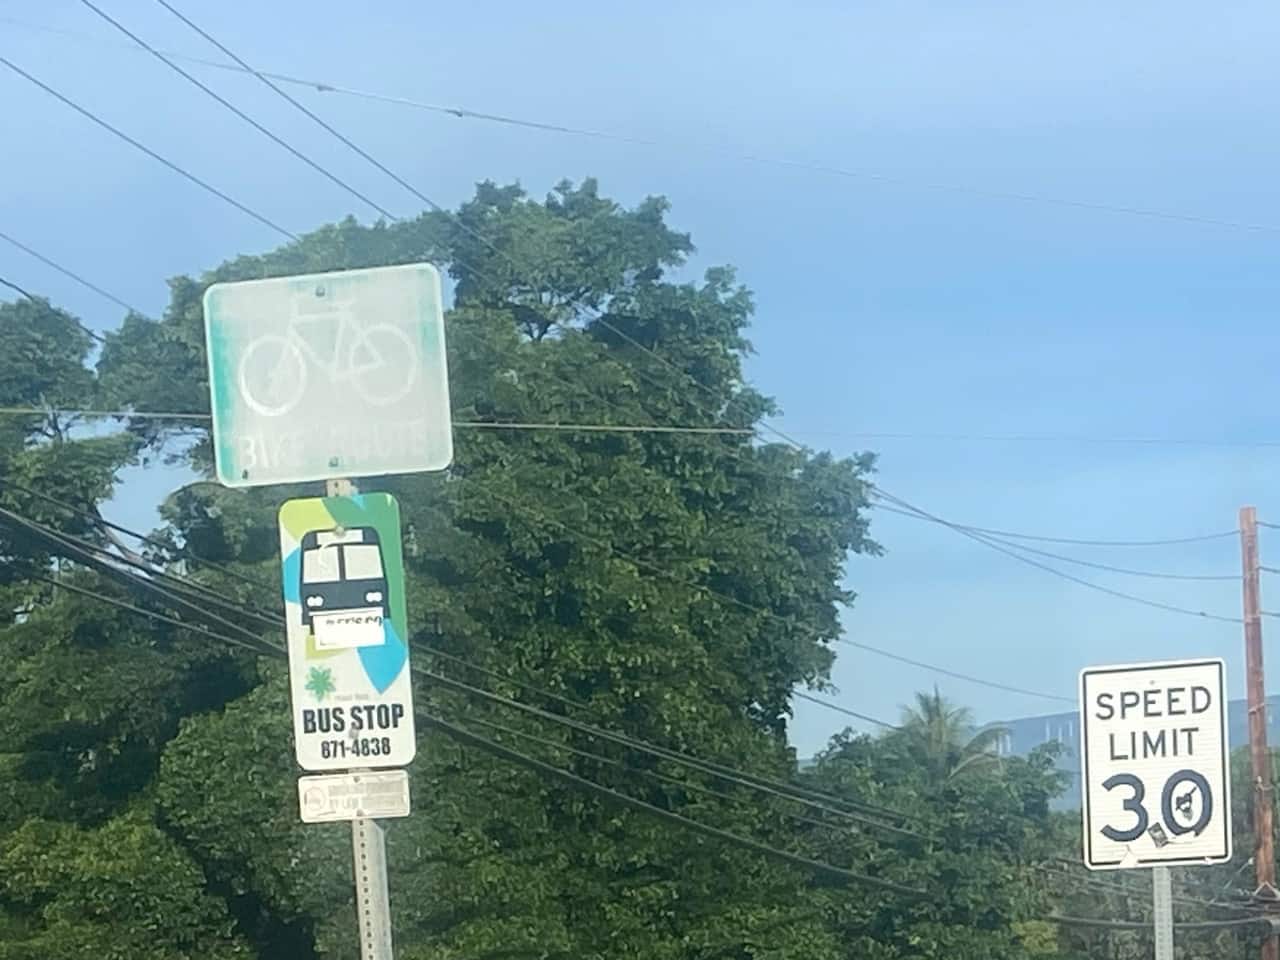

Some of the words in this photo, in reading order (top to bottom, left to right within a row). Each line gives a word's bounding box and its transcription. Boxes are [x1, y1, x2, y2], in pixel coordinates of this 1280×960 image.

[302, 707, 346, 734] BUS
[350, 703, 404, 731] STOP
[1096, 686, 1212, 720] SPEED
[321, 737, 391, 759] 871-4838
[1109, 727, 1199, 761] LIMIT
[1100, 768, 1213, 843] 30
